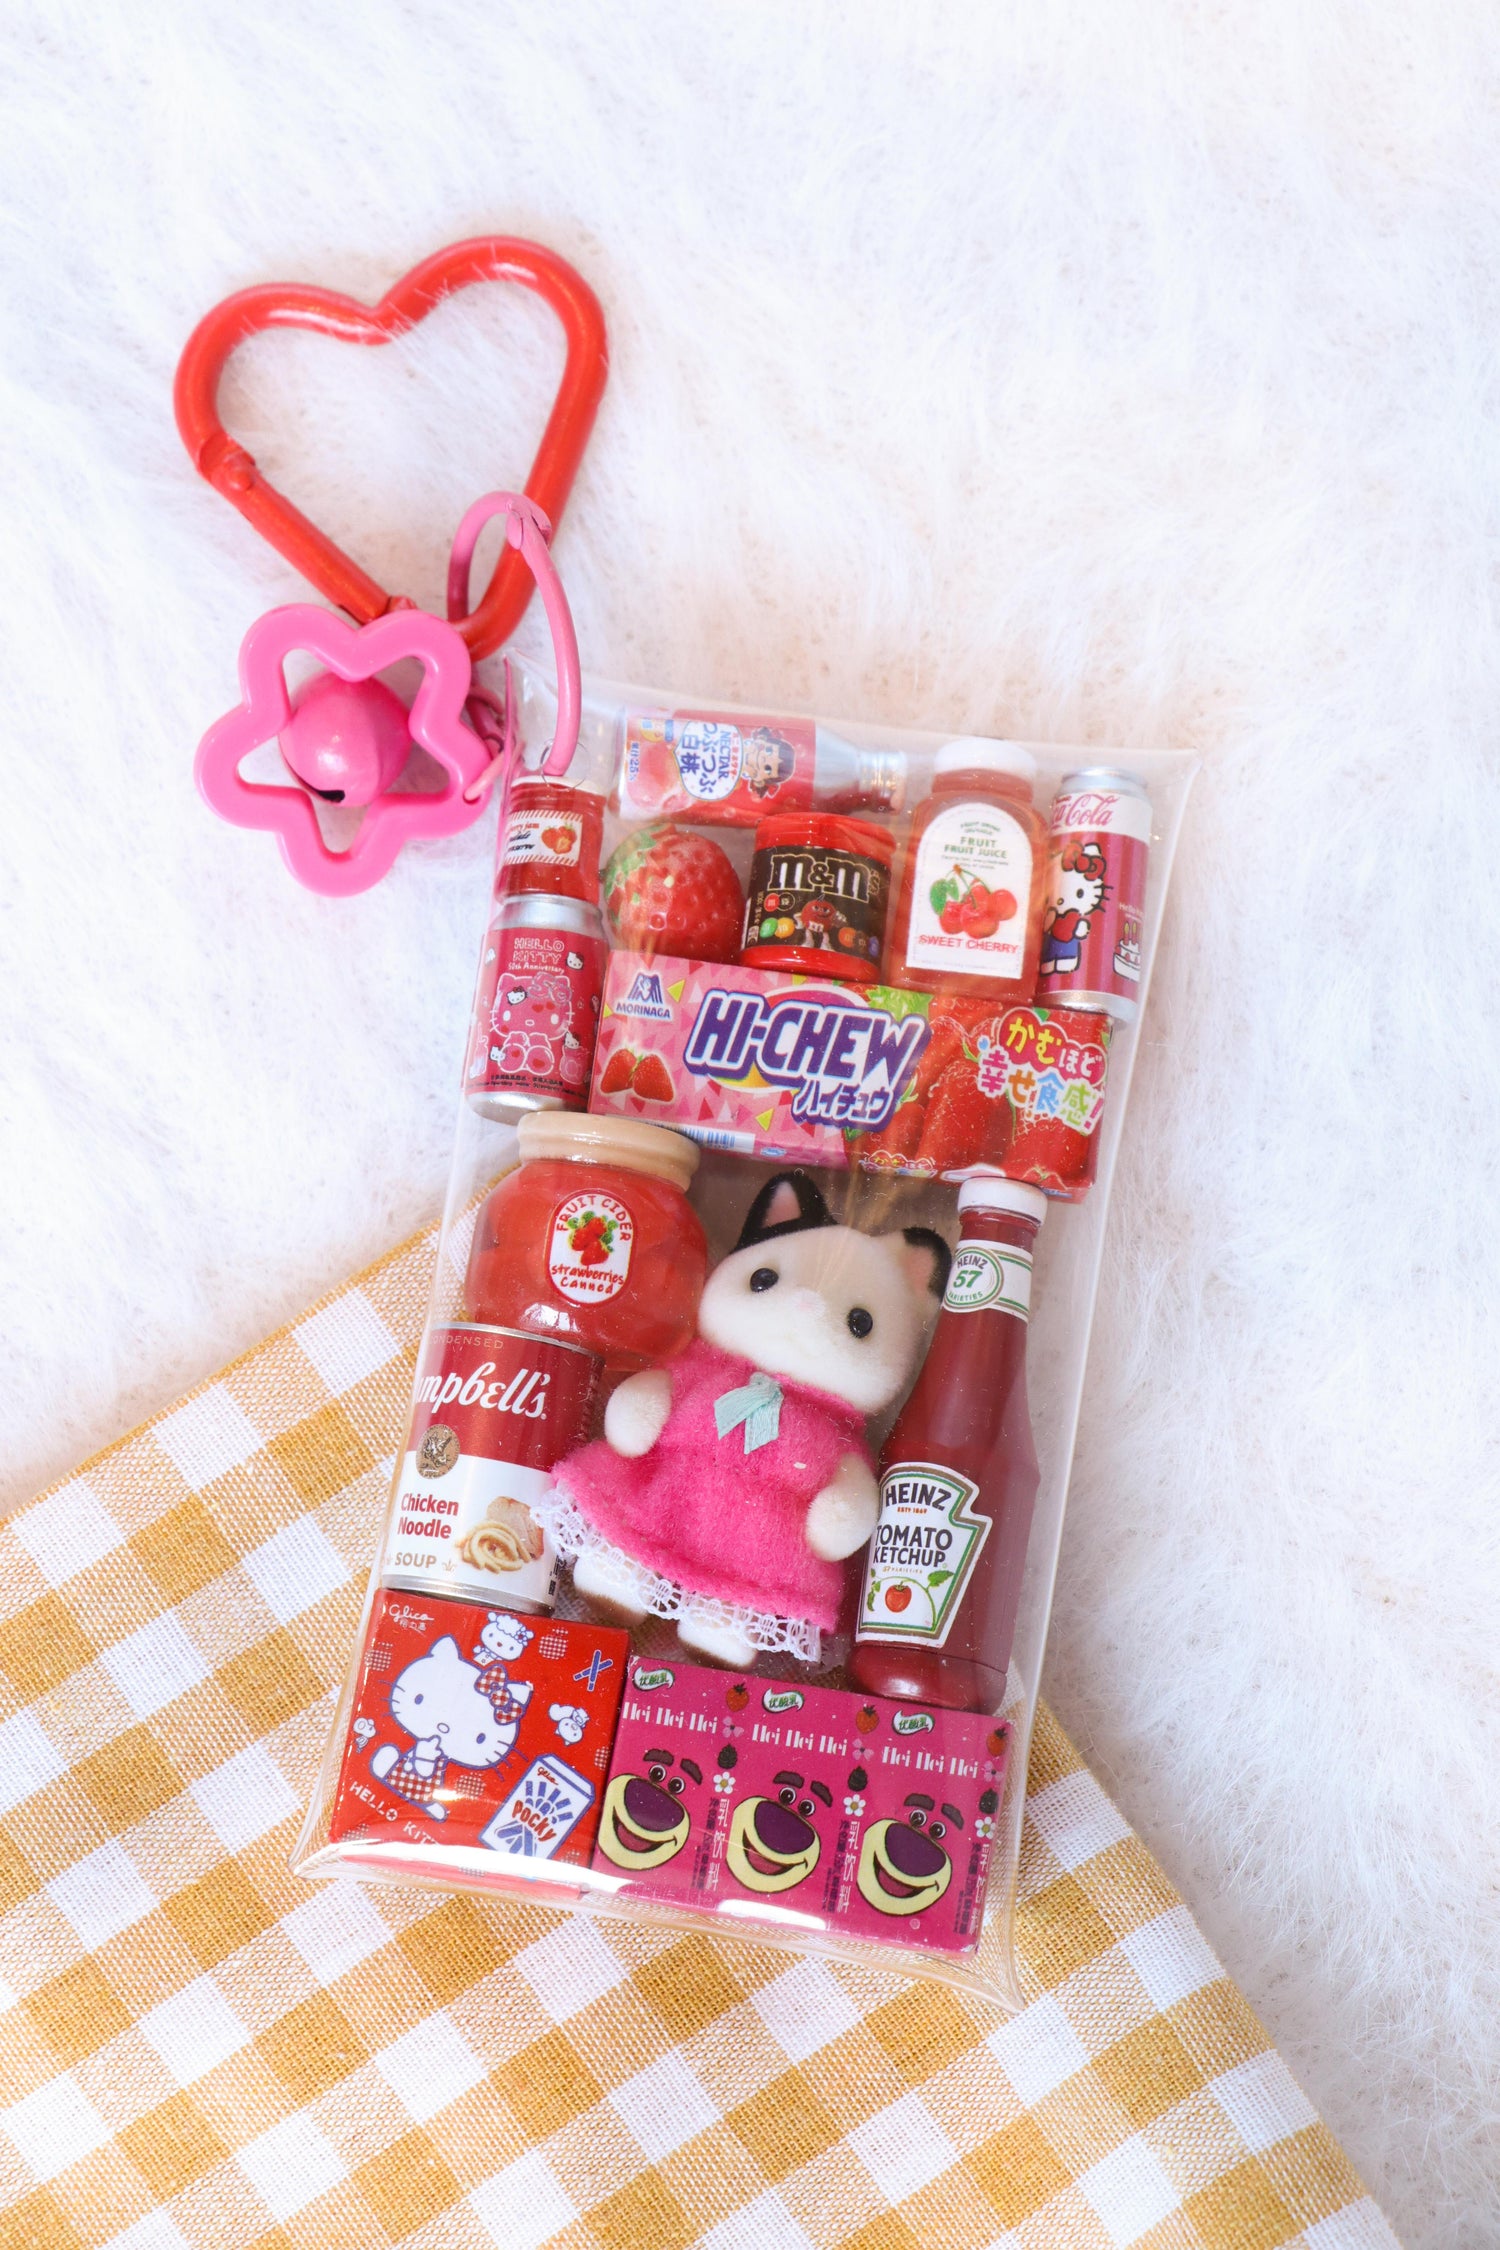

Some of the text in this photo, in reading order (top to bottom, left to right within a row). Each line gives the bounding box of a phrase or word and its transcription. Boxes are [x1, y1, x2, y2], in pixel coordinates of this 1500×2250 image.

[680, 734, 701, 775] 白桃
[699, 722, 718, 794] つぶつぶ
[718, 730, 731, 779] NECTAR
[944, 844, 1008, 859] FRUIT JUICE
[960, 836, 998, 848] FRUIT
[514, 937, 565, 952] HELLO
[918, 934, 1019, 954] SWEET CHERRY
[513, 950, 562, 965] KITTY
[523, 962, 565, 974] Anniversary
[616, 1003, 671, 1019] MORINAGA
[688, 991, 928, 1088] HI-CHEW
[1006, 1016, 1103, 1078] かむほど
[795, 1079, 889, 1119] ハイチュウ
[556, 1195, 632, 1242] FRUIT CIDER
[956, 1254, 988, 1271] HEINZ
[953, 1270, 983, 1289] 57
[401, 1493, 459, 1516] Chicken
[885, 1482, 952, 1511] HEINZ
[398, 1518, 452, 1539] Noodle
[875, 1524, 953, 1551] TOMATO
[395, 1553, 437, 1569] SOUP
[873, 1547, 946, 1568] KETCHUP
[349, 1781, 398, 1821] HELLO
